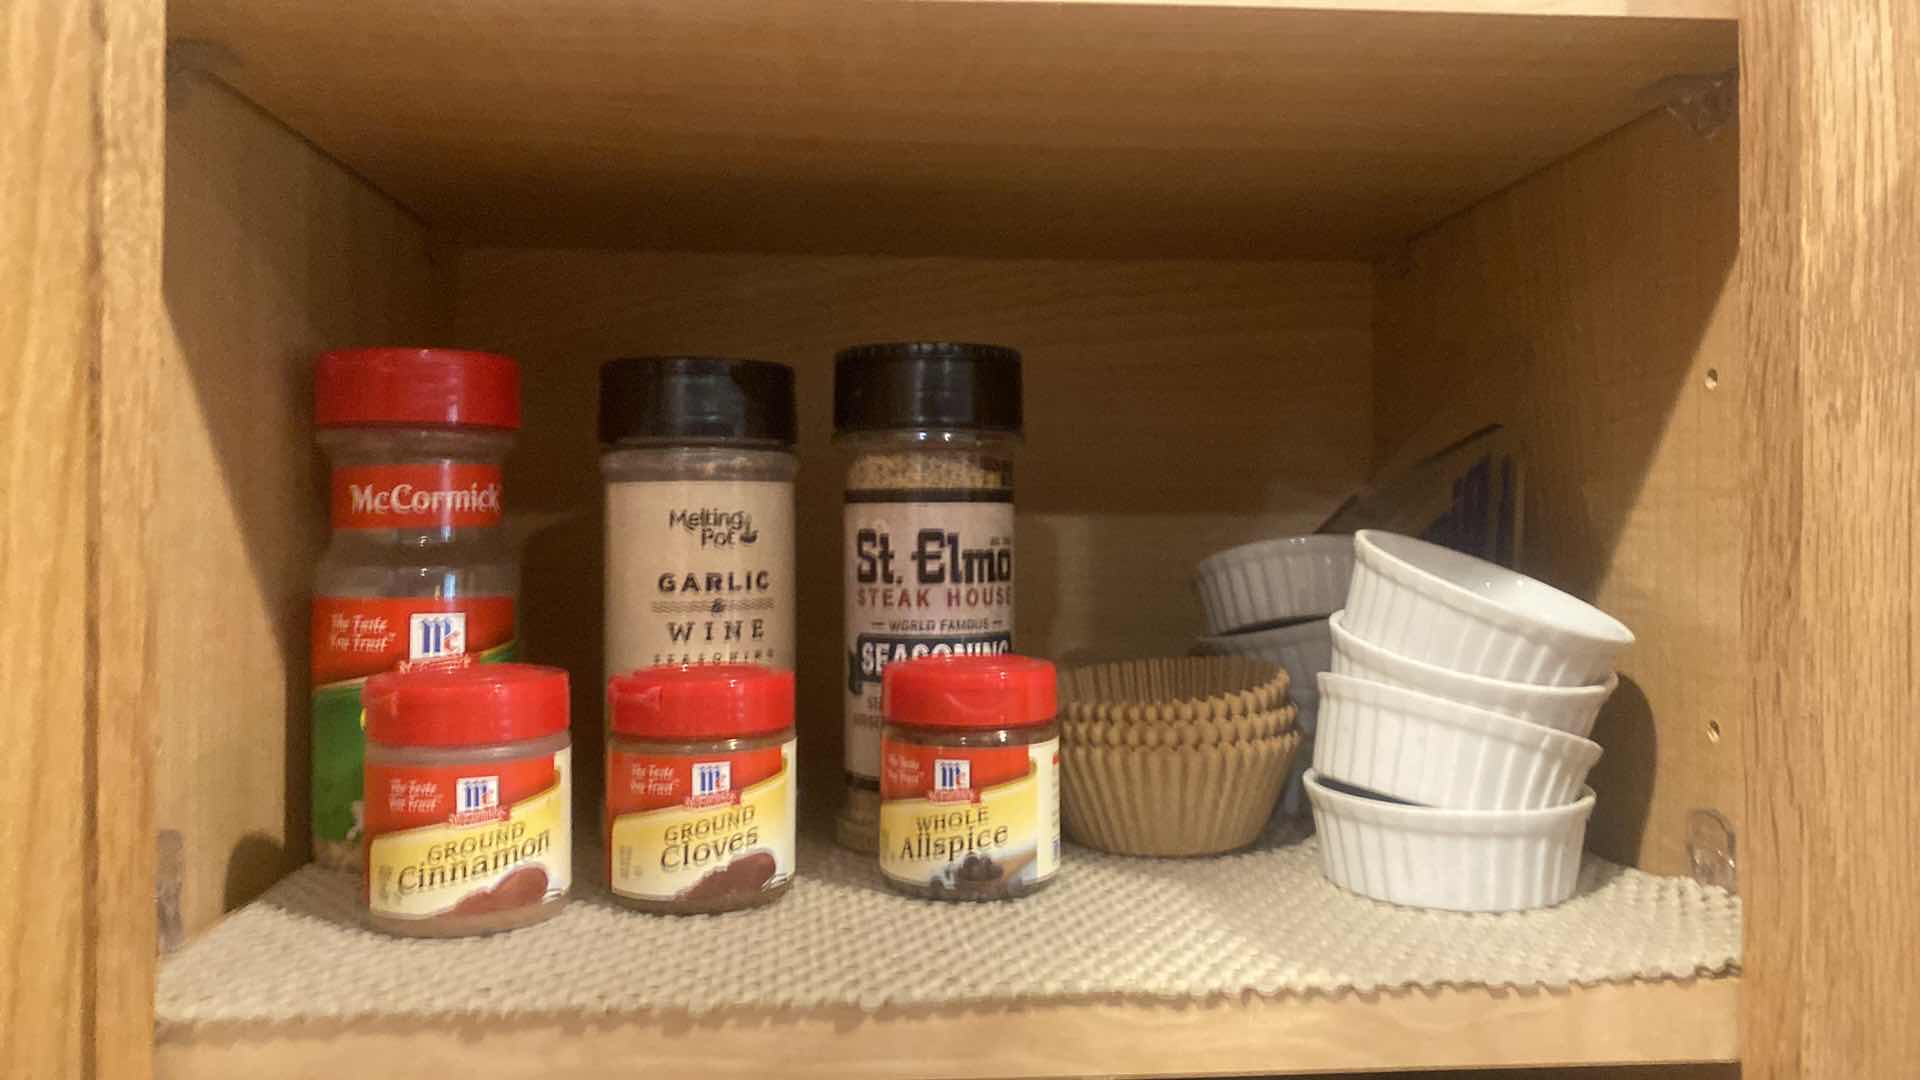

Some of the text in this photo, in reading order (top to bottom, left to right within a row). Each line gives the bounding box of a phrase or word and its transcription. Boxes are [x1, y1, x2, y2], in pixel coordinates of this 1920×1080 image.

[349, 482, 502, 513] McCormick
[669, 507, 745, 531] Melting
[701, 527, 737, 548] Pot
[856, 528, 1011, 585] St. Elmo
[657, 570, 770, 593] GARLIC
[710, 598, 725, 614] &
[857, 586, 1011, 608] STEAK HOUSE
[667, 619, 764, 643] WINE
[889, 618, 989, 632] WORLD FAMOUS
[663, 805, 756, 843] GROUND
[915, 806, 990, 832] WHOLE
[427, 821, 527, 865] GROUND
[660, 827, 760, 871] Cloves
[900, 826, 1009, 861] Allspice
[397, 830, 551, 893] Cinnamon
